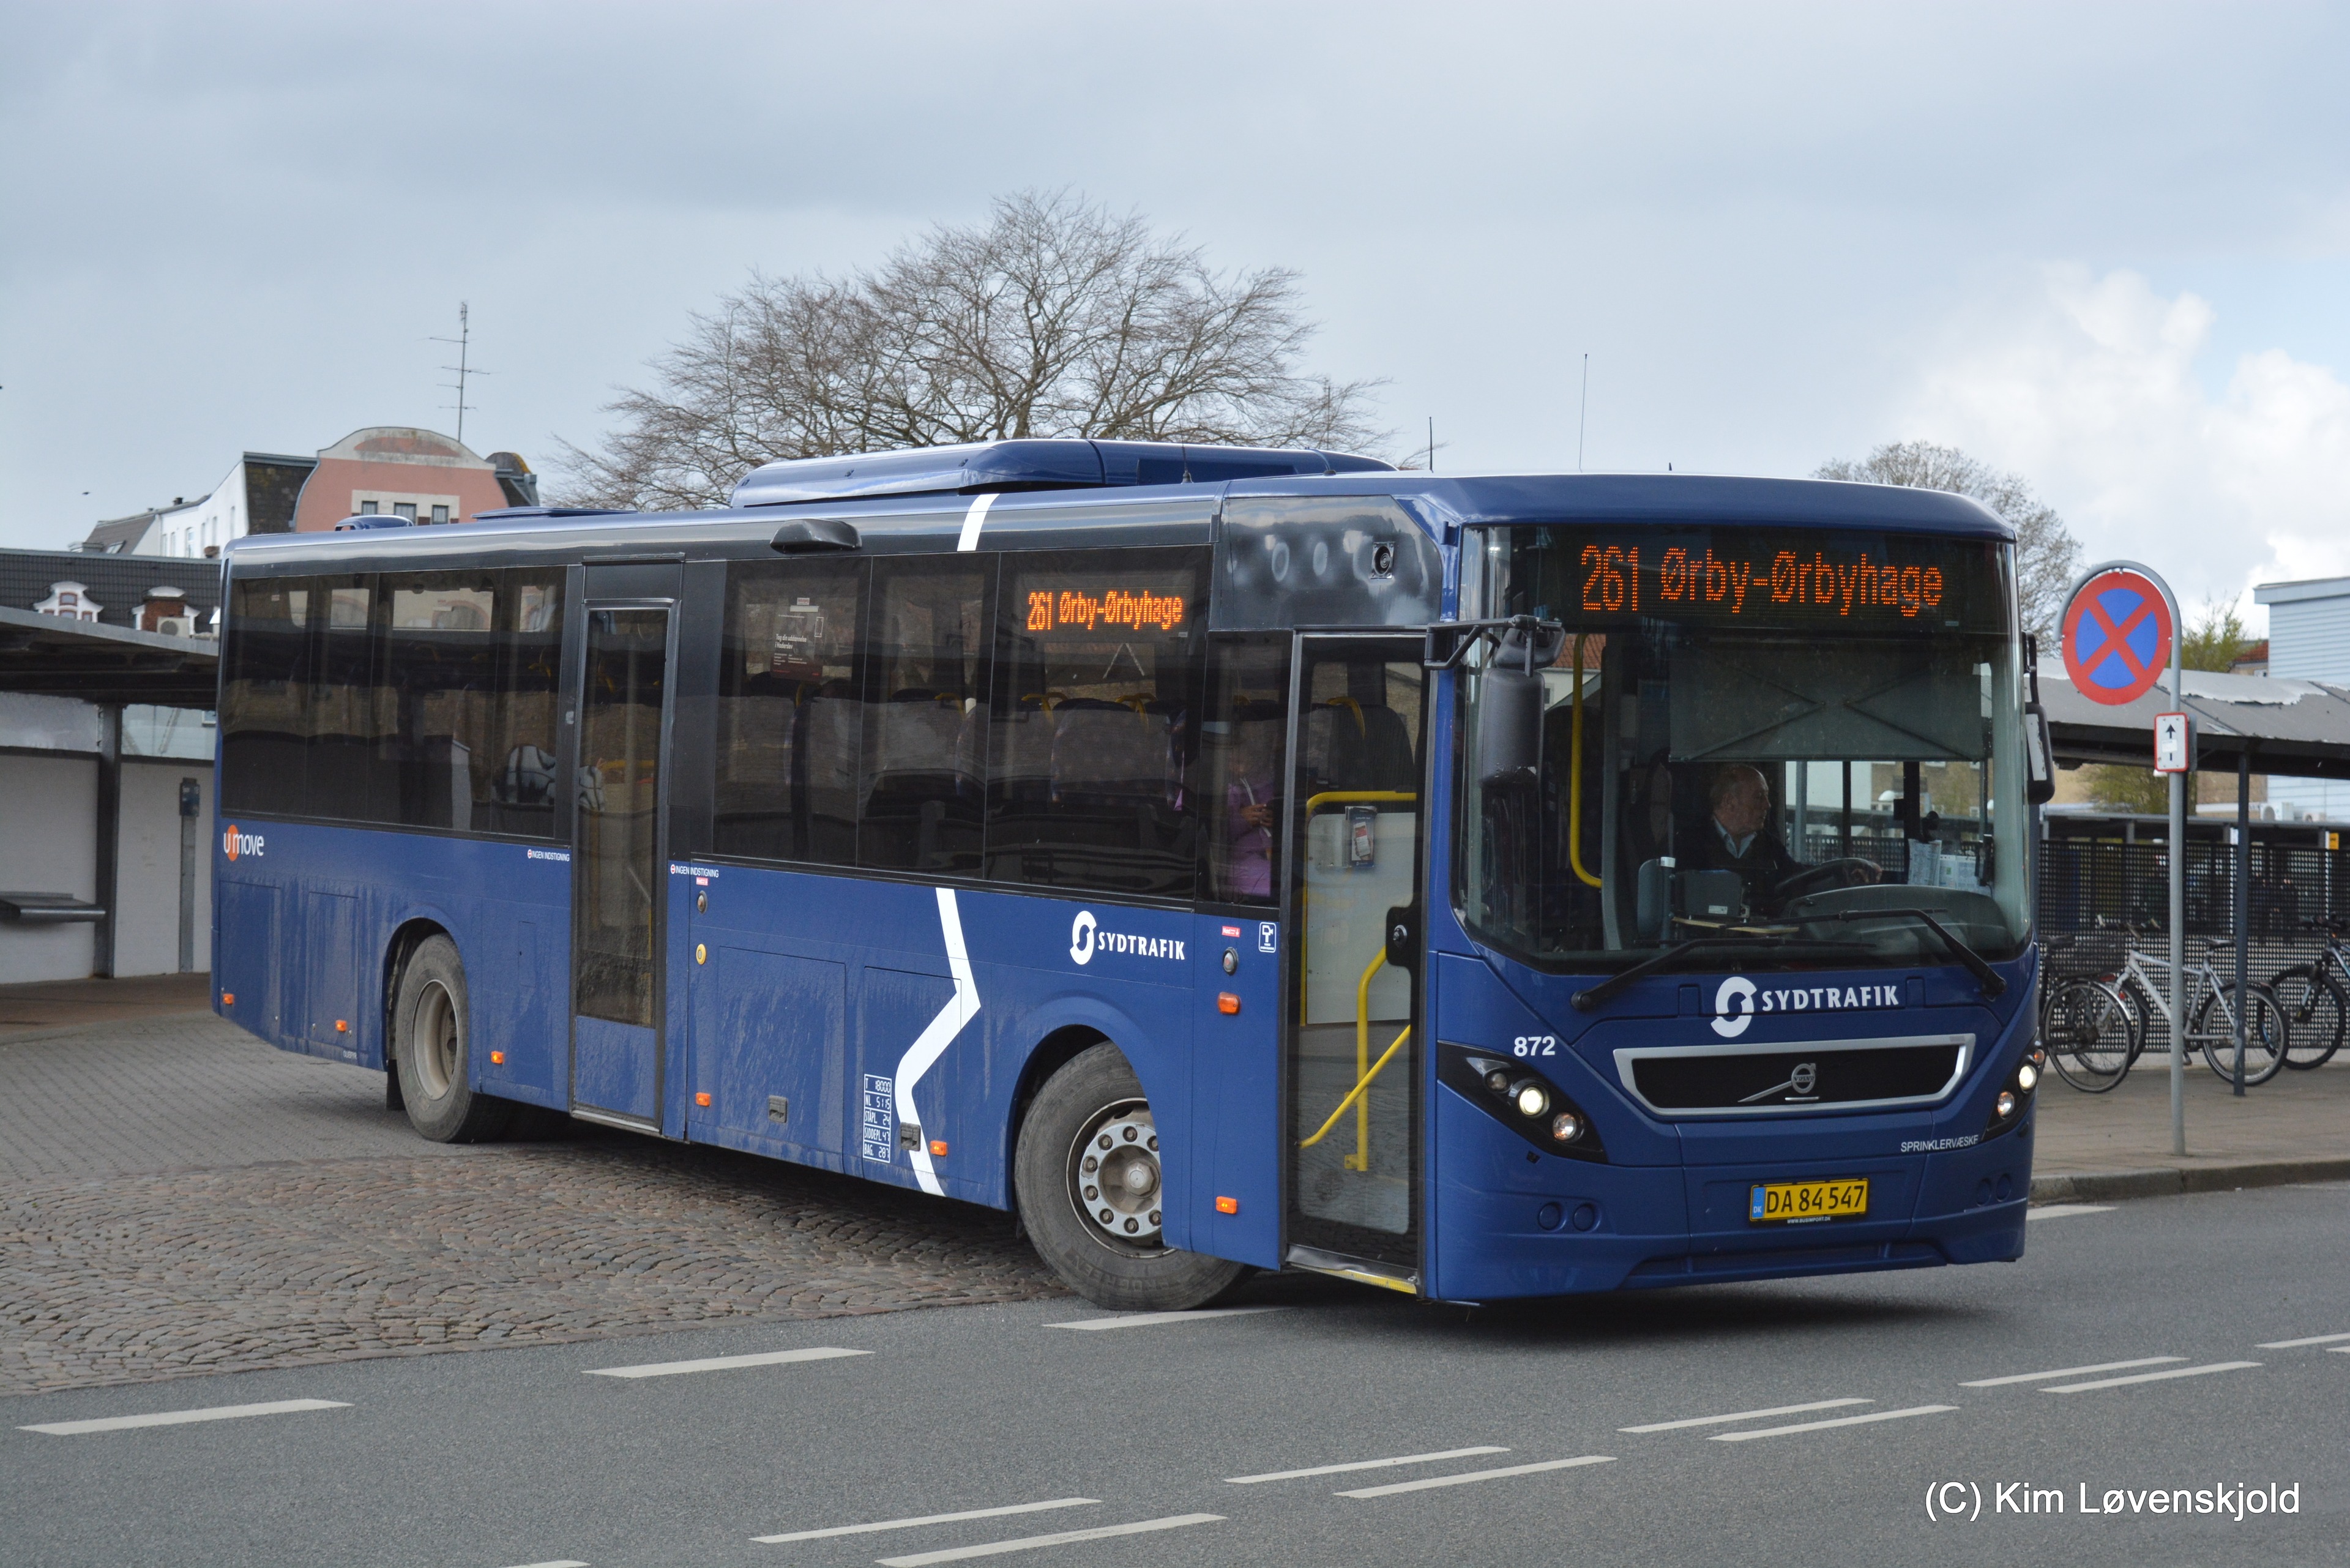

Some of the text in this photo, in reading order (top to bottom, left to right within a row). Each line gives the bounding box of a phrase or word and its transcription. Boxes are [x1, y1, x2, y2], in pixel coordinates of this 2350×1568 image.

[1581, 546, 1942, 616] 261 Ørby-Ørbyhage
[1028, 591, 1182, 629] 261 Ørby-Ørbyhage
[675, 865, 719, 878] INGEN INDSTIGNING
[1098, 931, 1185, 960] SYDTRAFIK
[1762, 985, 1898, 1012] SYDTRAFIK
[1513, 1036, 1555, 1056] 872
[865, 1078, 890, 1093] T 18000
[865, 1094, 890, 1110] NL 5115
[882, 1114, 890, 1126] 24
[882, 1132, 890, 1142] 47
[1901, 1135, 1979, 1152] SPRINKLERVÆSKE
[878, 1146, 889, 1159] 287
[1766, 1185, 1865, 1213] DA 84 547
